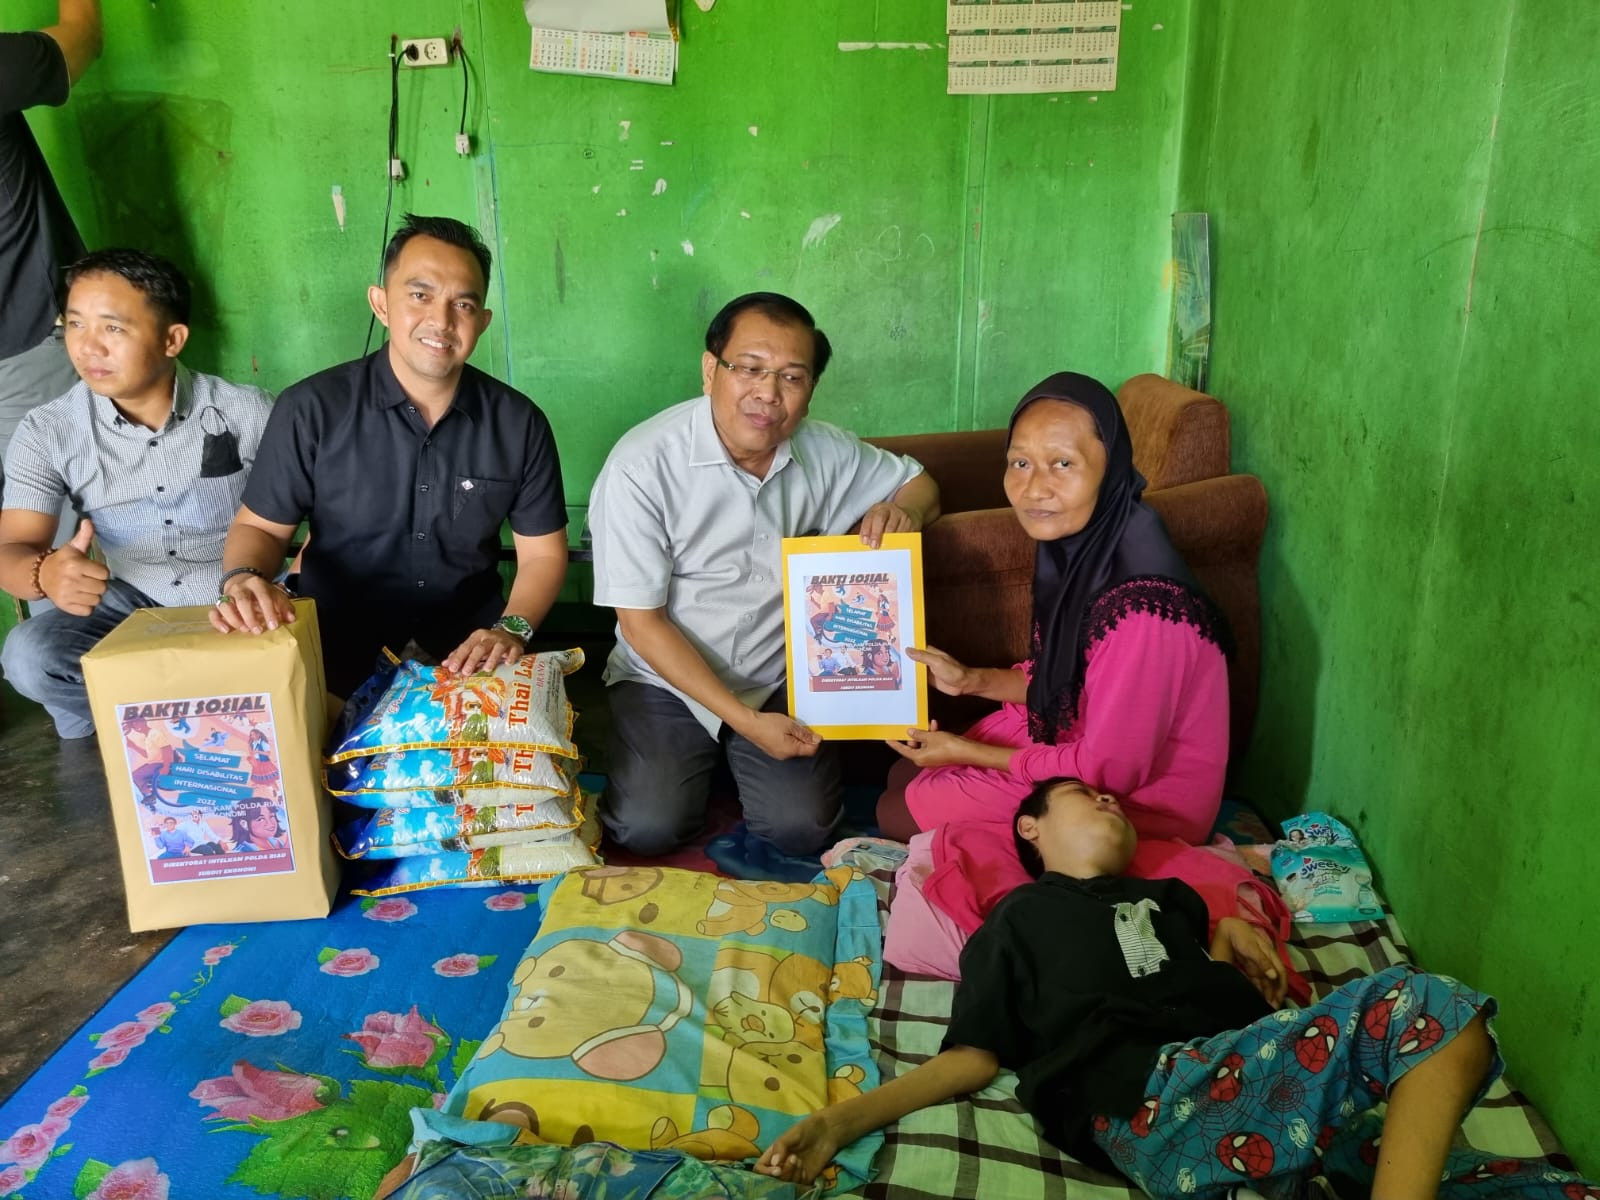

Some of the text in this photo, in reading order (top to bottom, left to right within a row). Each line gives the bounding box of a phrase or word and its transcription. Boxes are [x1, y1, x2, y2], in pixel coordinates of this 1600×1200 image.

[811, 573, 889, 584] BAKTI SOSIAL
[123, 695, 266, 720] BAKTI SOSIAL
[508, 682, 532, 728] Thai
[194, 753, 231, 764] SELAMAT
[175, 766, 244, 781] HARI DISABILITAS
[174, 779, 237, 794] INTERNASIONAL
[196, 797, 217, 806] 2022
